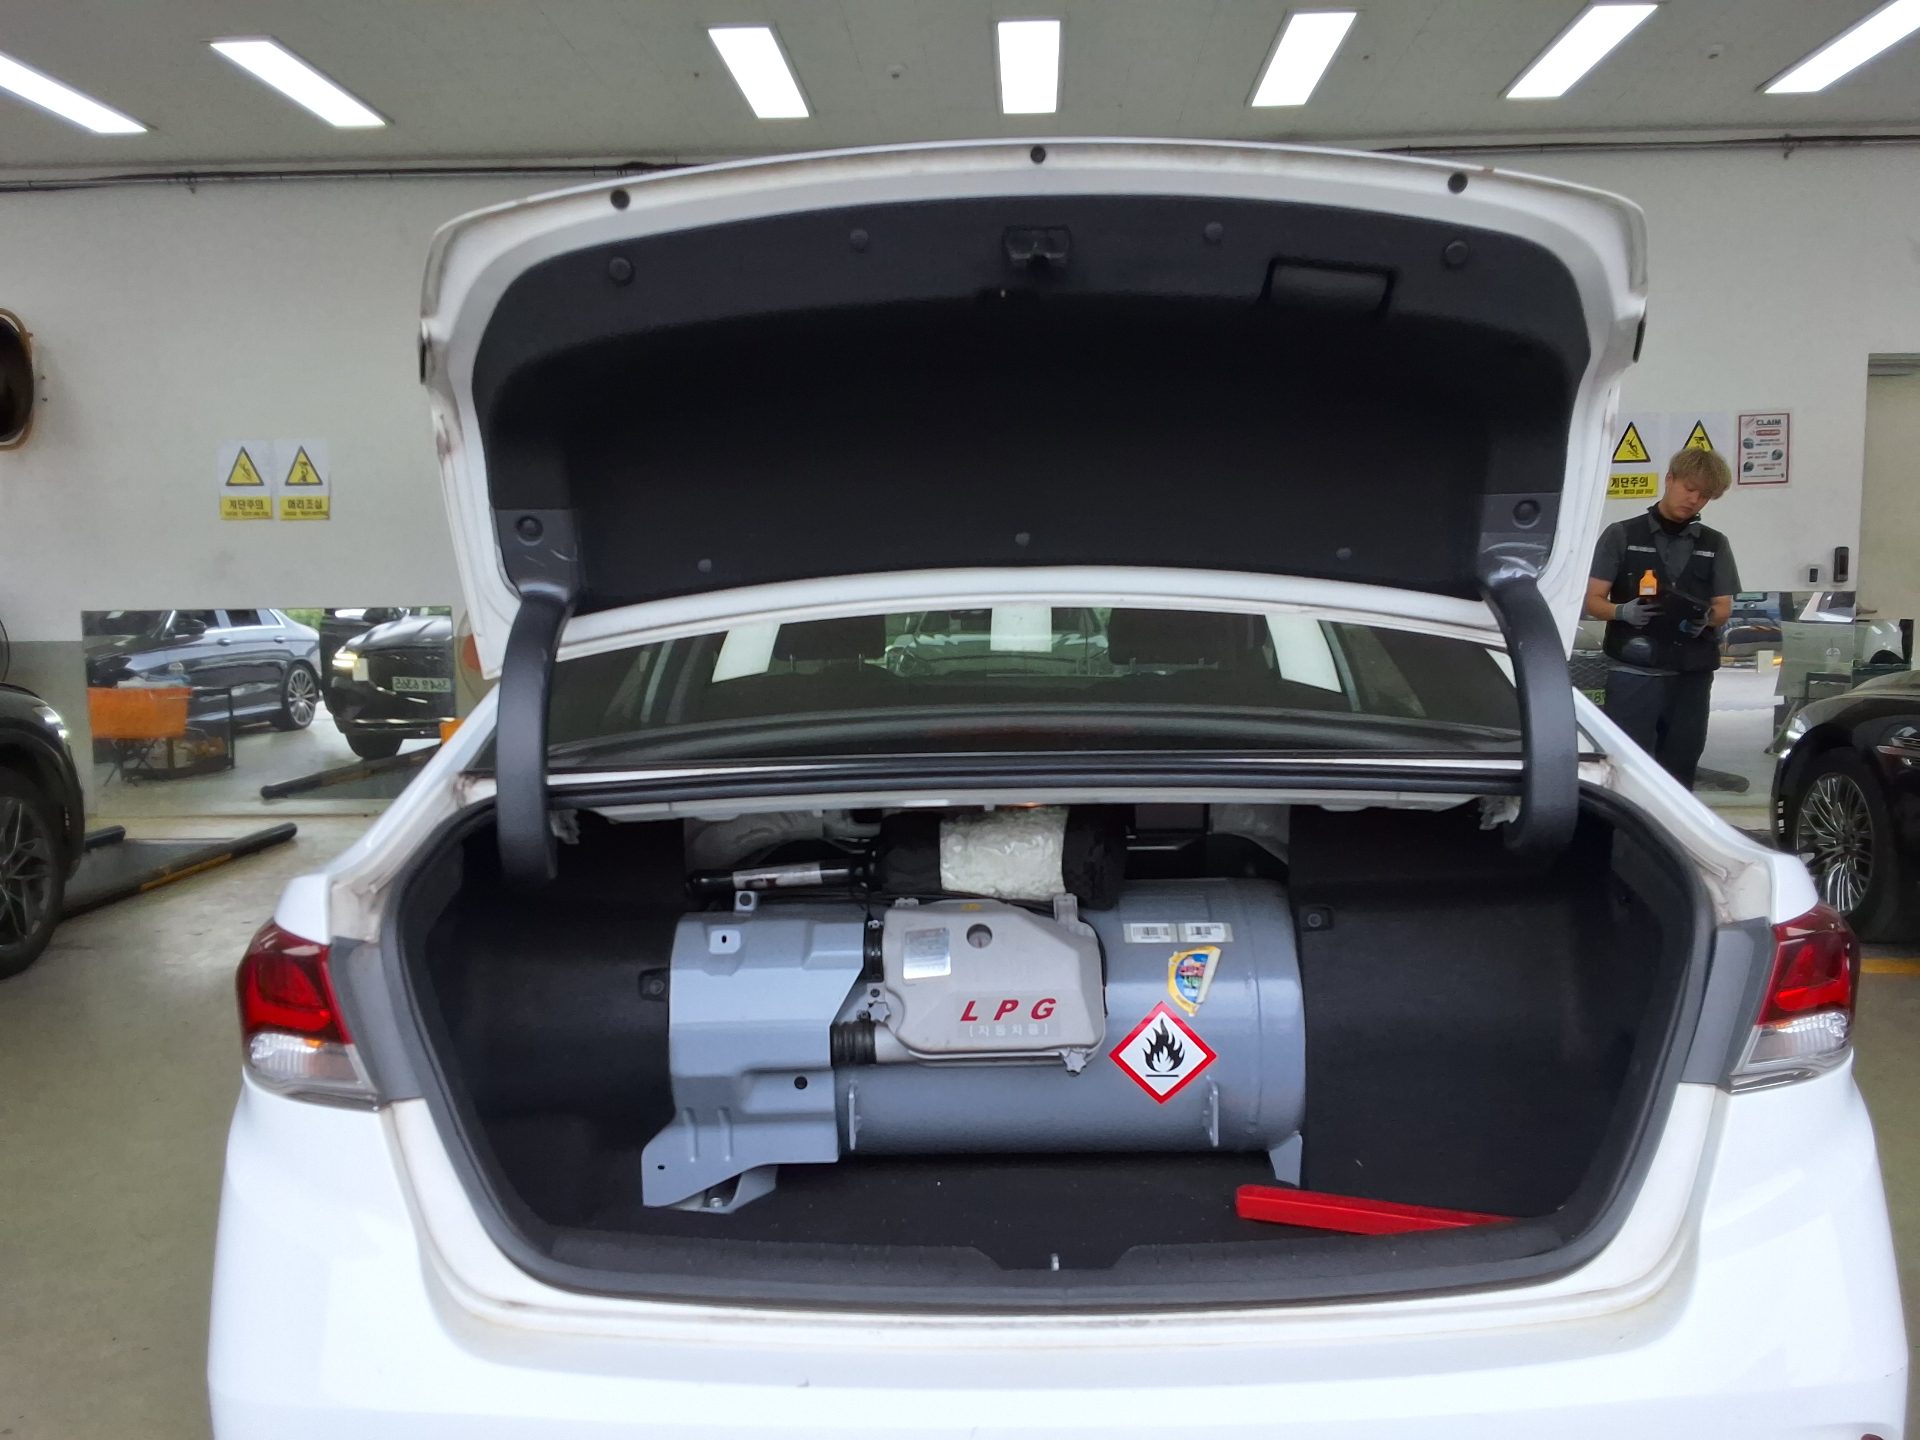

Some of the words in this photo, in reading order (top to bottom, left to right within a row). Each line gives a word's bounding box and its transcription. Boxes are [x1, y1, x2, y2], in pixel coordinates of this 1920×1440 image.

[1756, 418, 1782, 426] CLAIM
[1610, 475, 1649, 488] 계단주의
[960, 998, 1057, 1022] LPG
